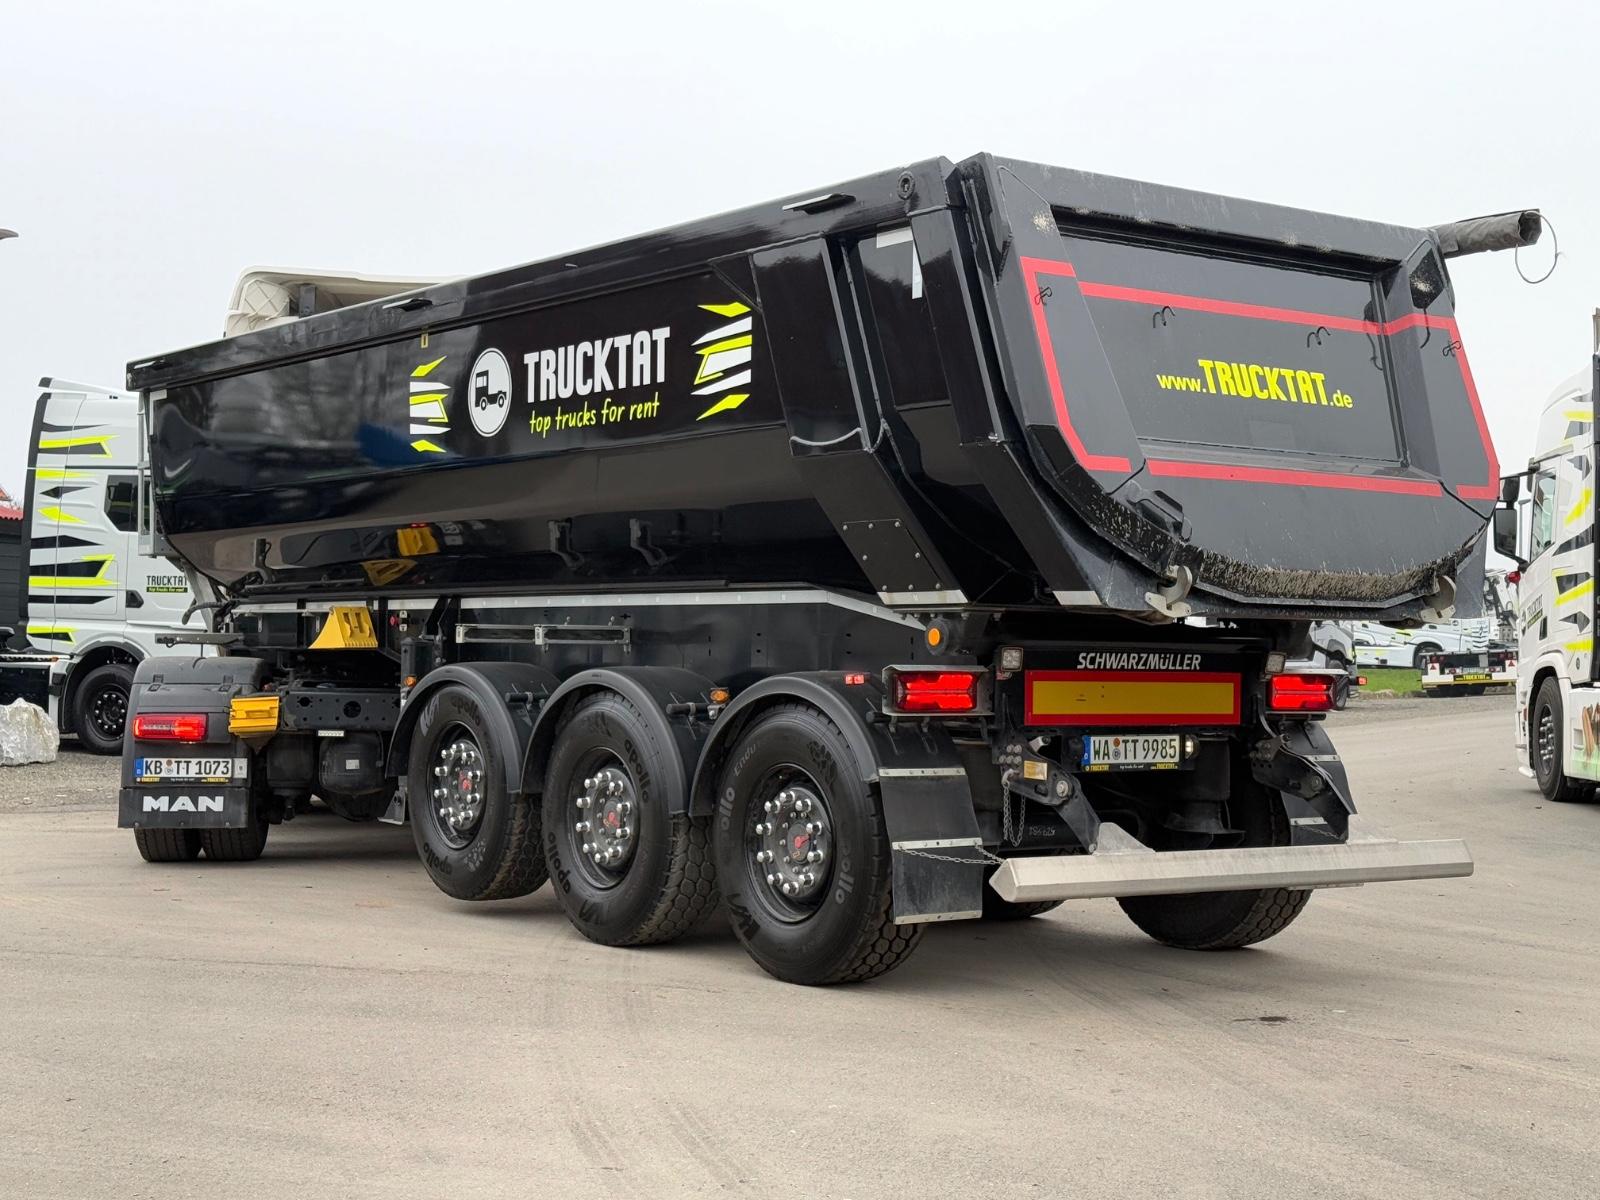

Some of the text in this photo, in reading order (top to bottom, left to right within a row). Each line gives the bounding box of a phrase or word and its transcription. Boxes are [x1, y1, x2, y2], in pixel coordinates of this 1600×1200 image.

[524, 326, 670, 403] TRUCKTAT
[1156, 359, 1353, 408] www.TRUCKTAT.de
[529, 391, 660, 439] top trucks for rent
[144, 760, 230, 775] KB TT 1073
[624, 738, 651, 803] apollo
[1093, 738, 1177, 760] WA TT 9985
[142, 795, 224, 812] MAN
